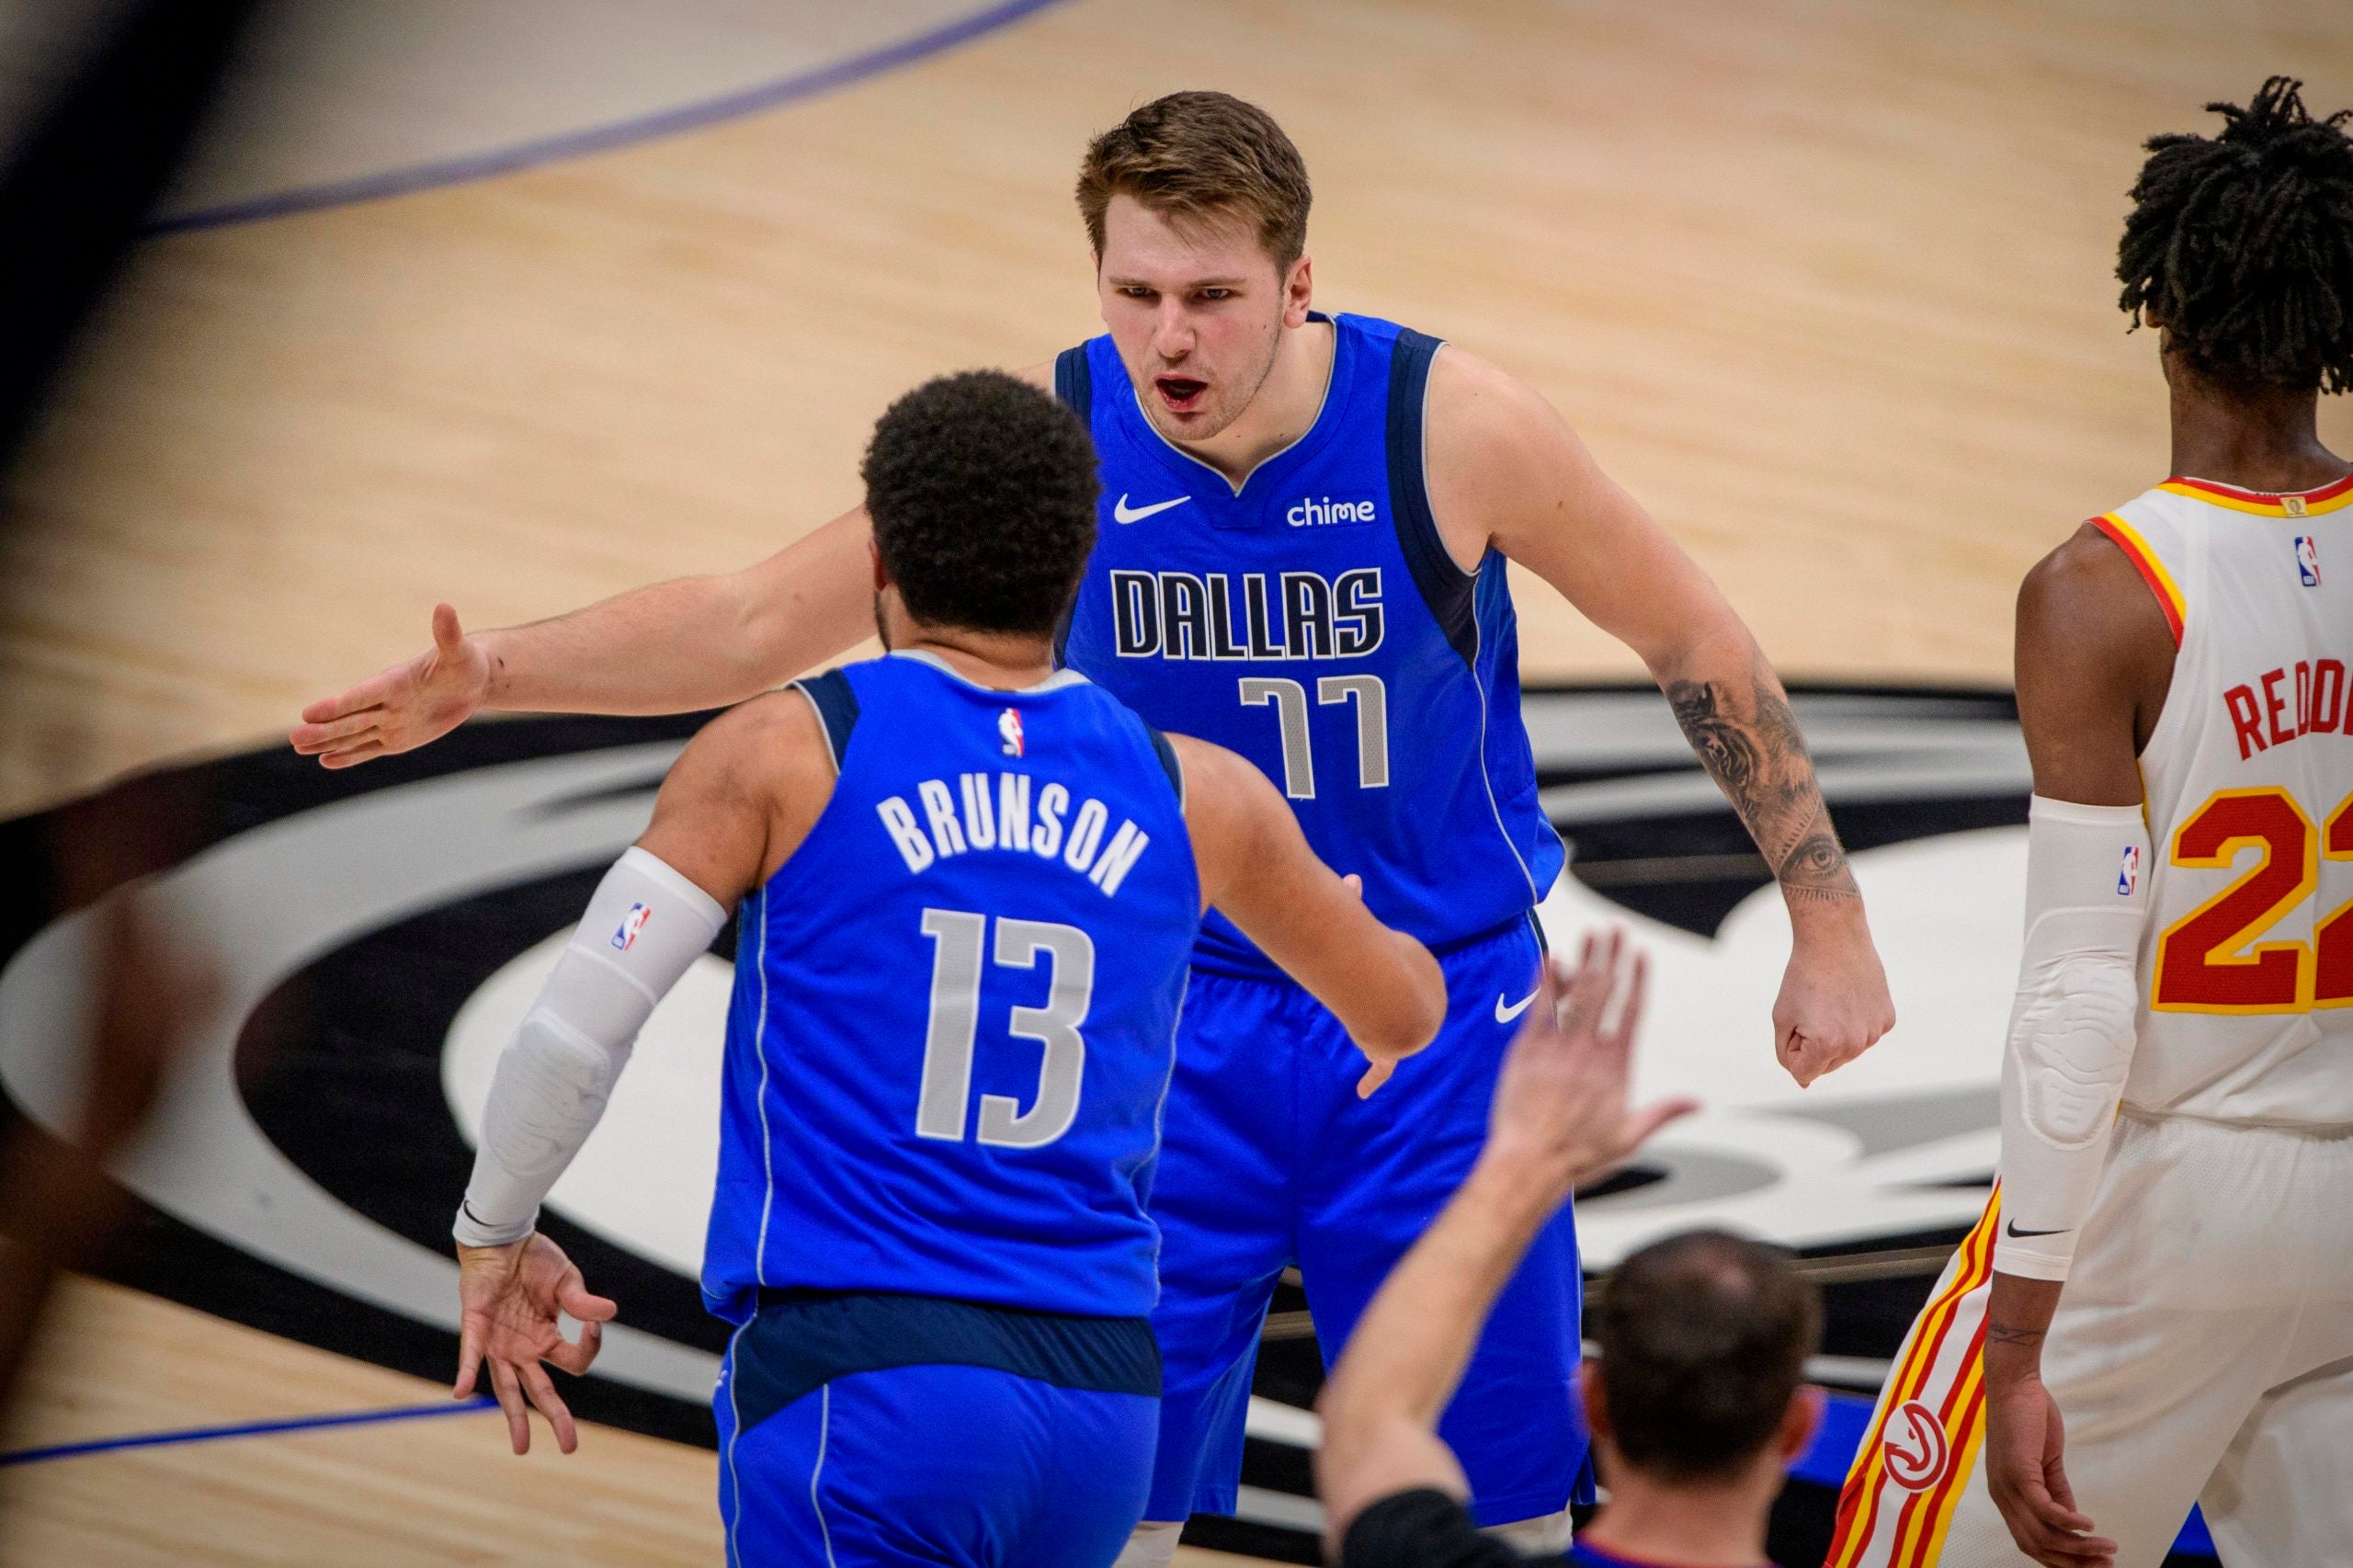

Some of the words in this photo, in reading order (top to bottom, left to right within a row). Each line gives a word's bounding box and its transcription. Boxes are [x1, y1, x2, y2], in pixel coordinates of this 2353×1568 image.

[1287, 496, 1376, 528] chime
[1109, 567, 1385, 661] DALLAS
[1237, 674, 1390, 800] 77
[876, 772, 1151, 898] BRUNSON
[2150, 785, 2353, 1016] 2
[915, 907, 1097, 1149] 13
